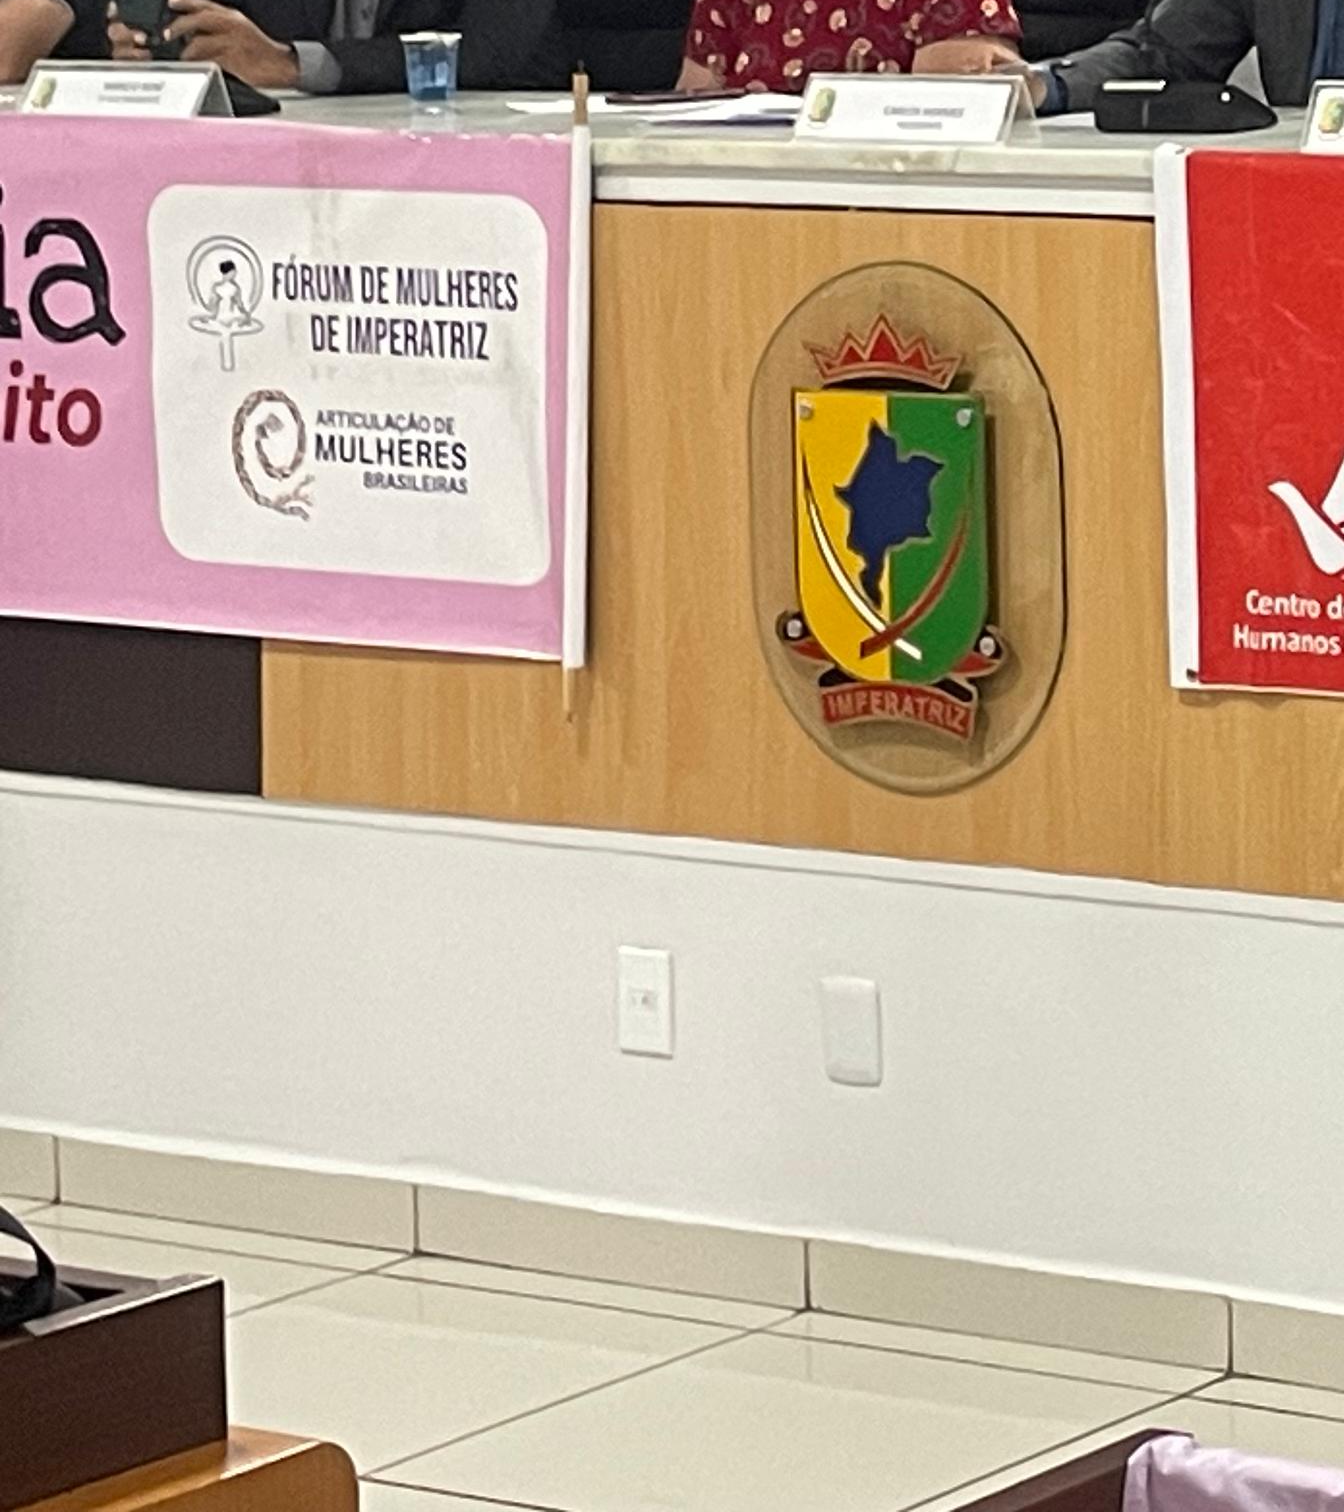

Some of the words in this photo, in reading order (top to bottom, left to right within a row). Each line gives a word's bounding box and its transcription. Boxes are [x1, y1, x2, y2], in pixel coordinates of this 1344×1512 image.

[272, 253, 353, 303] FÓRUM
[360, 265, 389, 305] DE
[396, 267, 518, 312] MULHERES
[310, 314, 340, 353] DE
[346, 315, 489, 361] IMPERATRIZ
[315, 409, 430, 436] ARTICULAÇÃO
[434, 416, 455, 436] DE
[314, 433, 467, 471] MULHERES
[363, 471, 468, 495] BRASILEIRAS
[1245, 589, 1321, 619] Centro
[1233, 623, 1342, 656] Humanos
[826, 690, 967, 732] IMPERATRIZ
